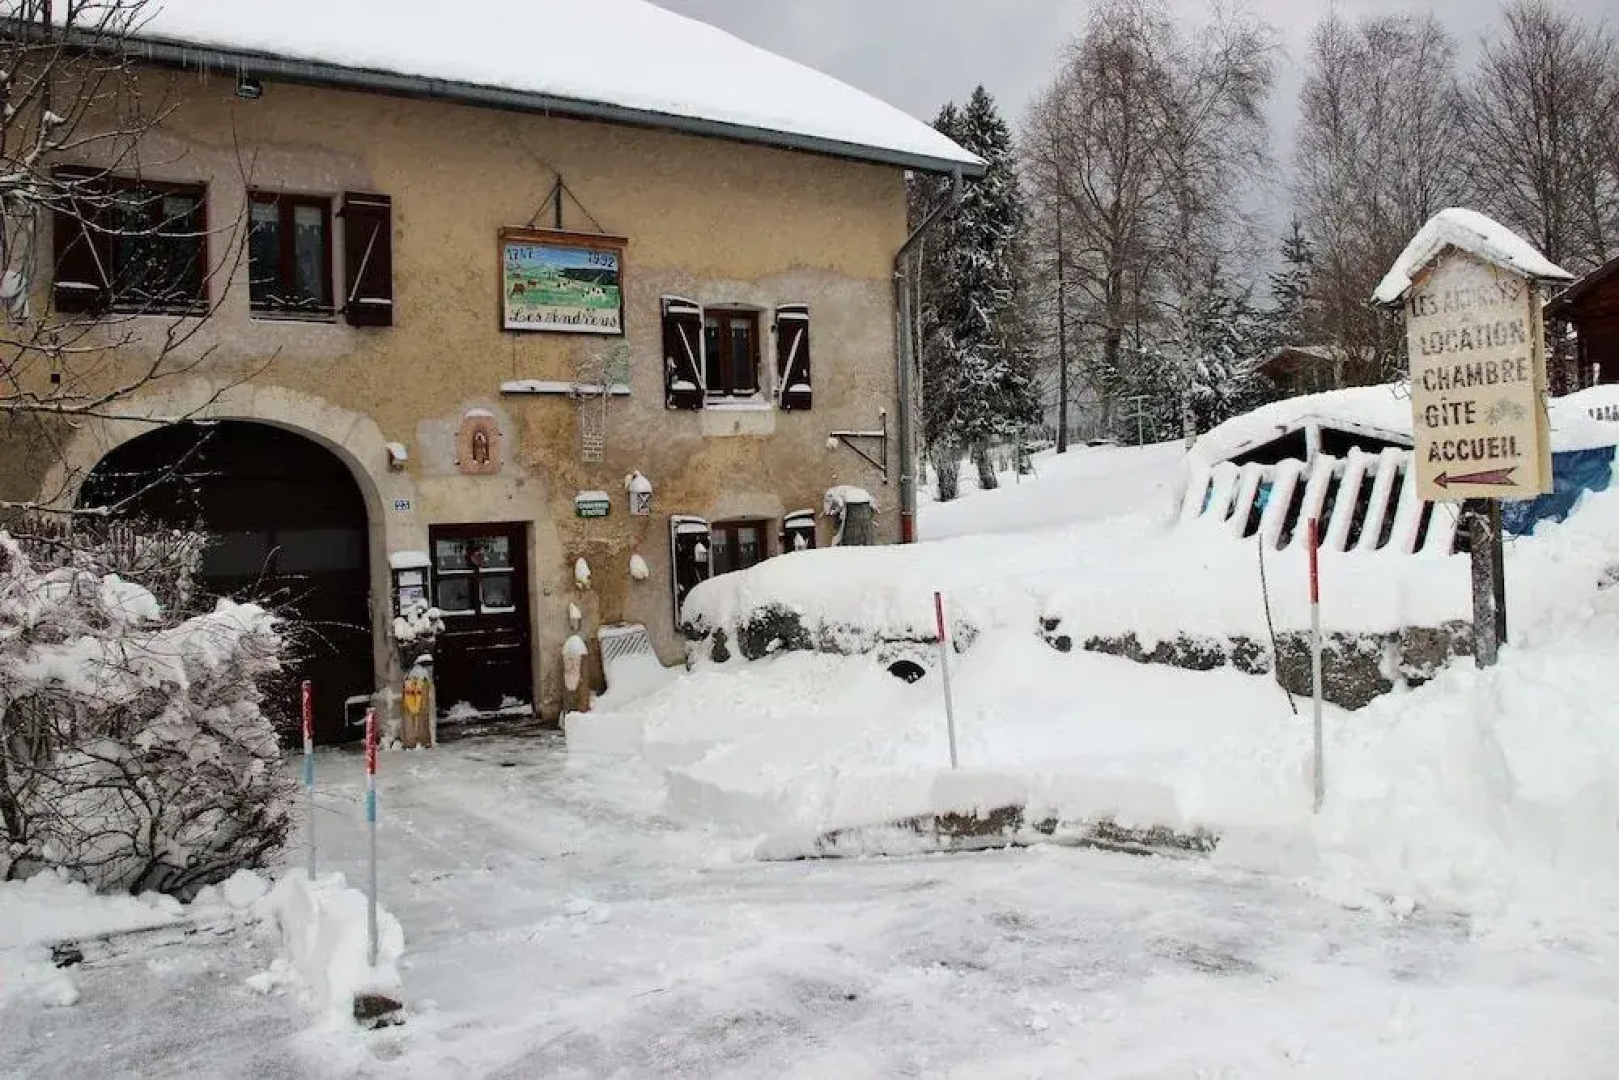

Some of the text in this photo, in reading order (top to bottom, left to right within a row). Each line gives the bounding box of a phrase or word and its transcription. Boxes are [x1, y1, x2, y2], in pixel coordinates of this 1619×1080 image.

[509, 307, 541, 323] Les
[1420, 318, 1526, 356] LOCATION
[1422, 356, 1528, 393] CHAMBRE
[1425, 397, 1476, 428] GÎTE
[1428, 435, 1521, 463] ACCUEIL
